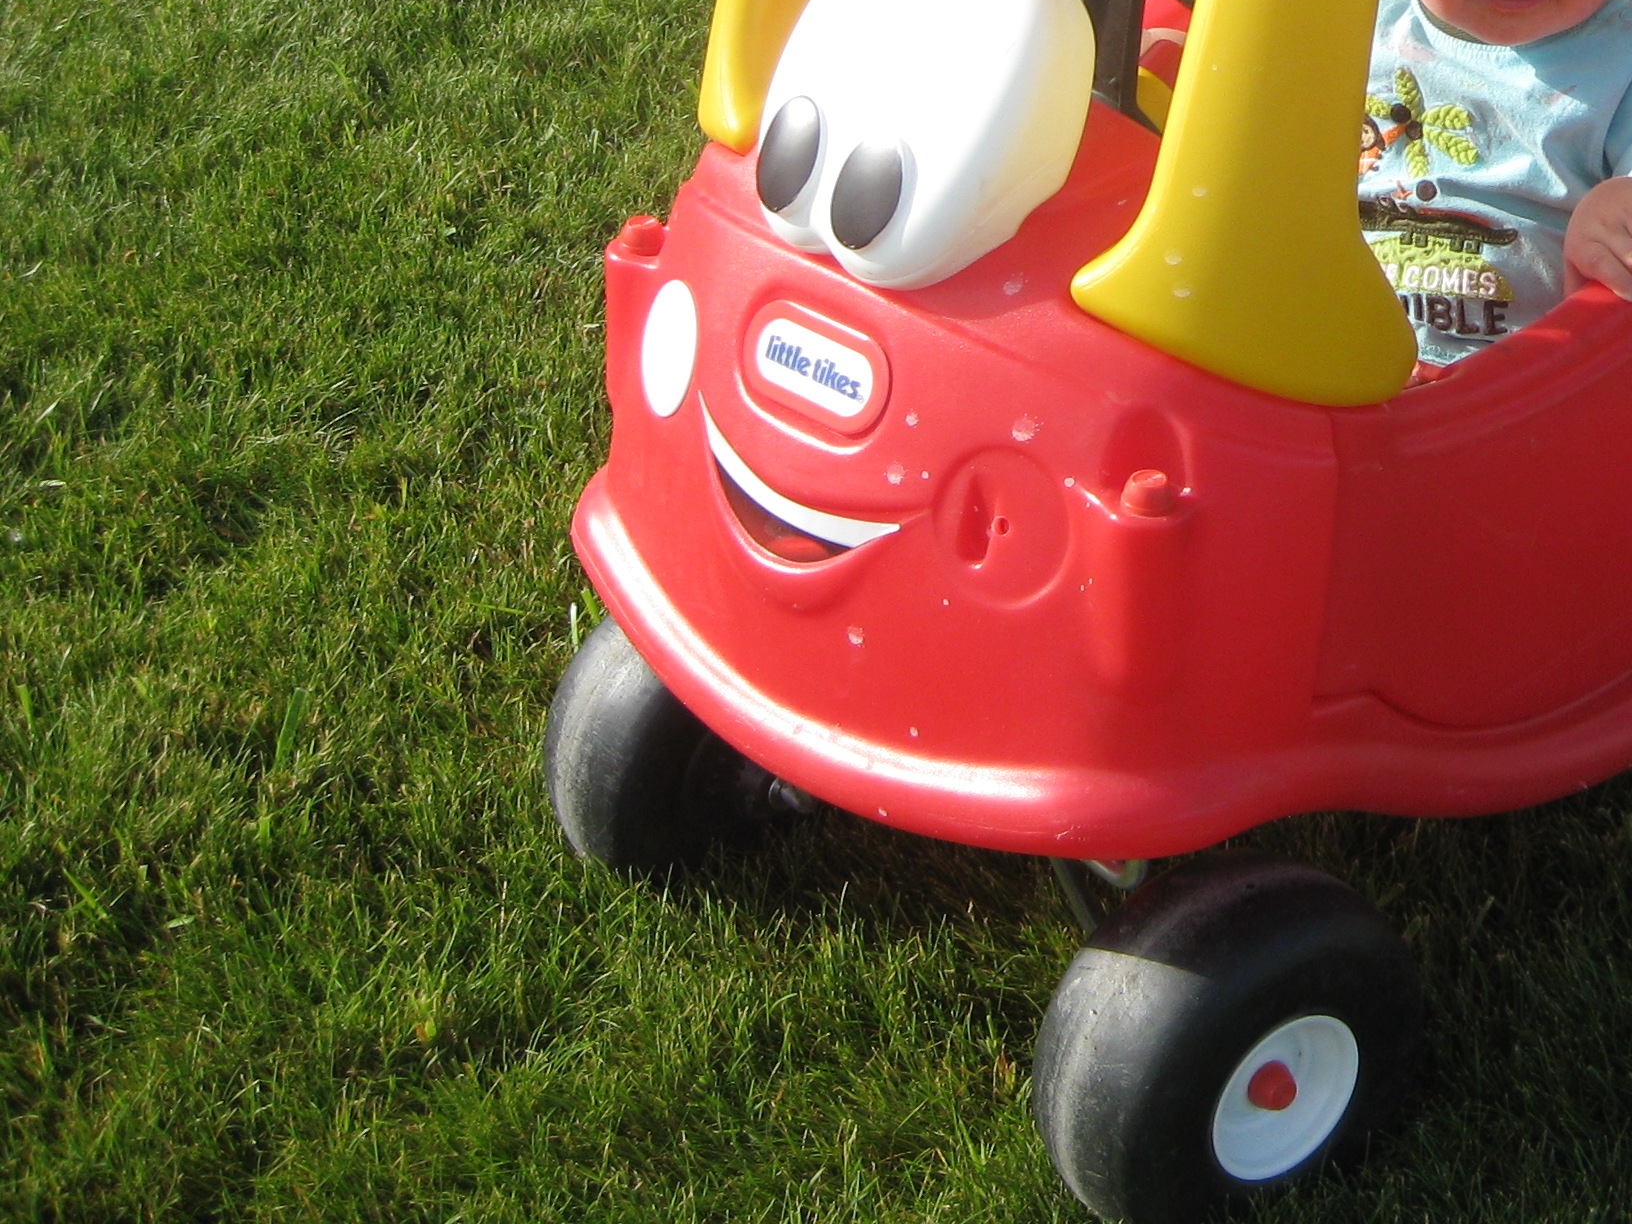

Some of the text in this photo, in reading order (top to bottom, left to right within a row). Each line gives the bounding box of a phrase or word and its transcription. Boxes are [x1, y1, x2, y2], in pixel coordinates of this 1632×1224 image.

[1404, 264, 1498, 297] COMES
[765, 335, 861, 400] little tikes
